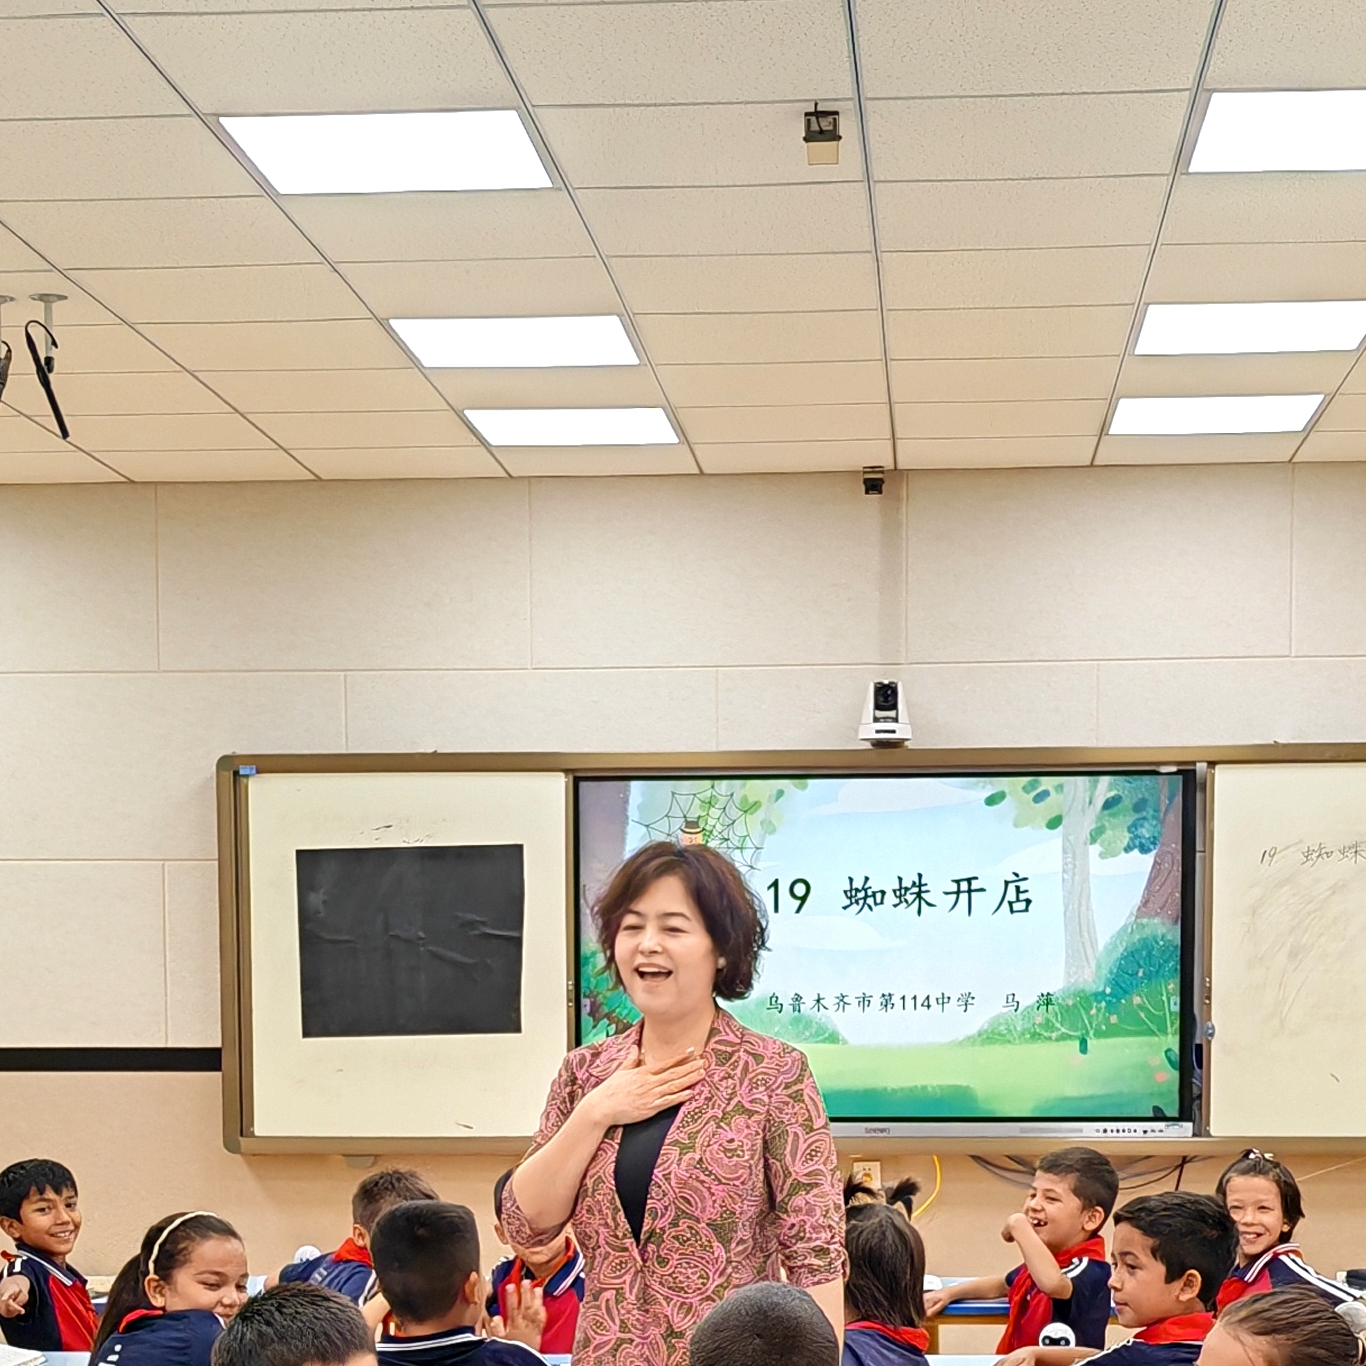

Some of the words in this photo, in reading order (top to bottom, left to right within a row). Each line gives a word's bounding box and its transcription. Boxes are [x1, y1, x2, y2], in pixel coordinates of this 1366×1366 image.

[1259, 845, 1278, 867] 19
[766, 877, 812, 915] 19
[841, 871, 1034, 918] 蜘蛛开店
[765, 992, 977, 1014] 乌鲁木齐市第114中学
